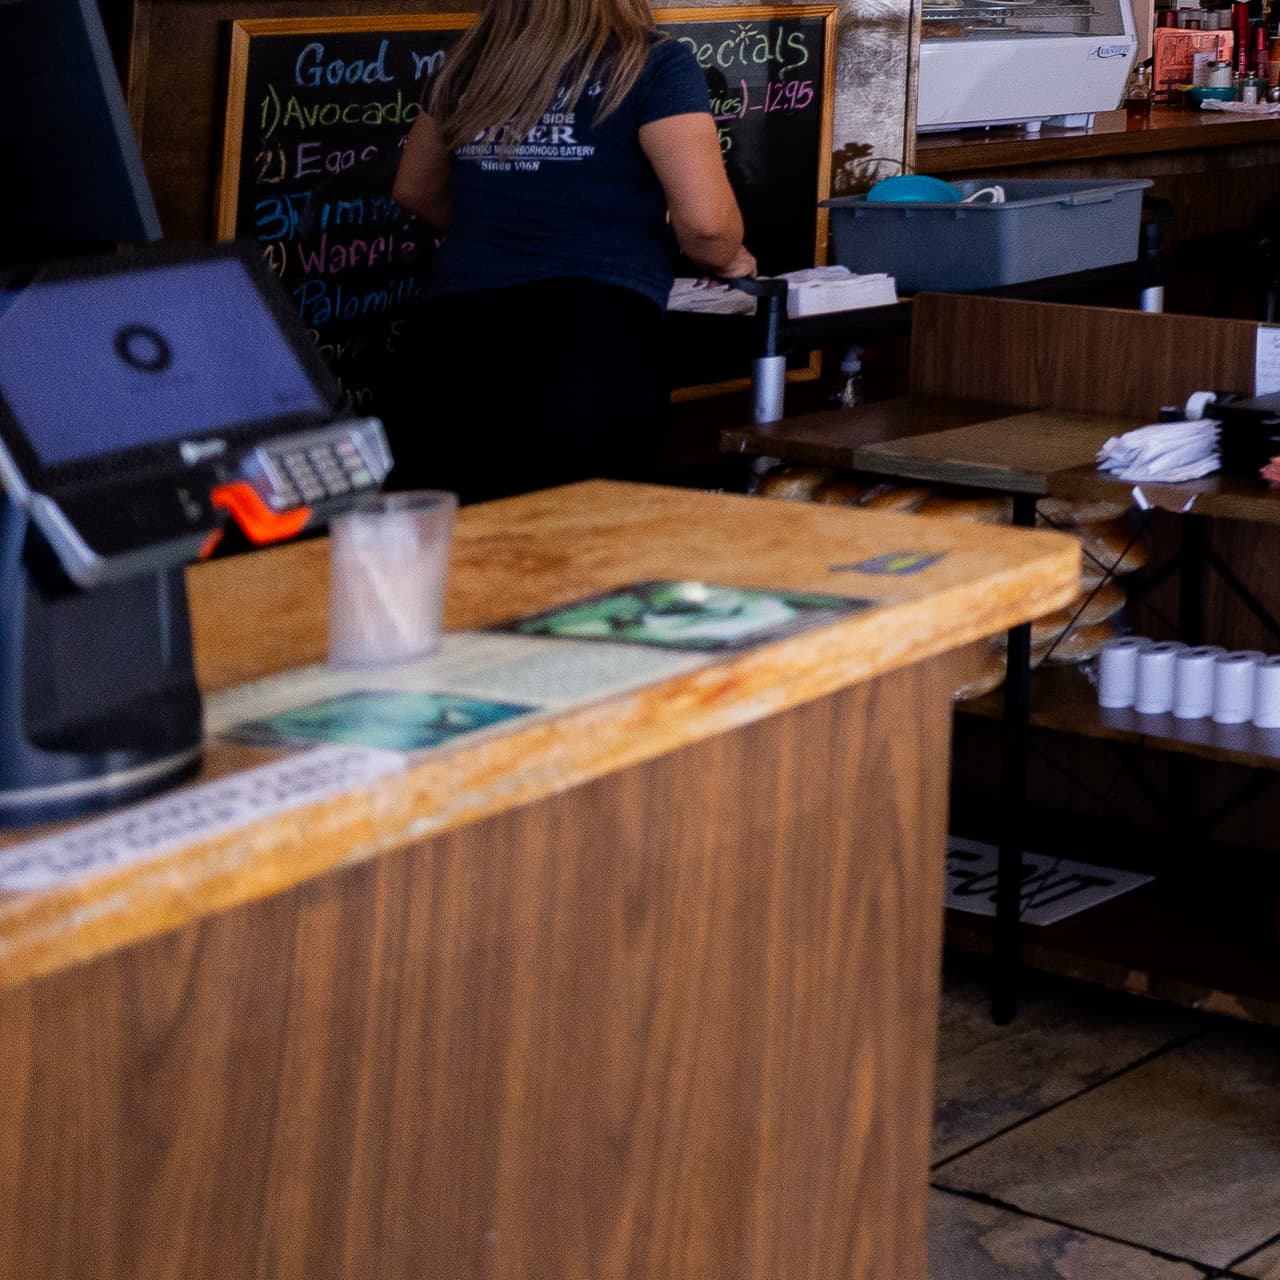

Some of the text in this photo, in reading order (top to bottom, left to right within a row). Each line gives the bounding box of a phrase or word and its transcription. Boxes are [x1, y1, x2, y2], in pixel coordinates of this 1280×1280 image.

[295, 38, 394, 87] Good
[677, 25, 809, 78] ecials
[284, 89, 422, 129] Avocado
[542, 113, 576, 124] SIDE
[560, 145, 595, 156] EATERY
[481, 160, 511, 172] Since
